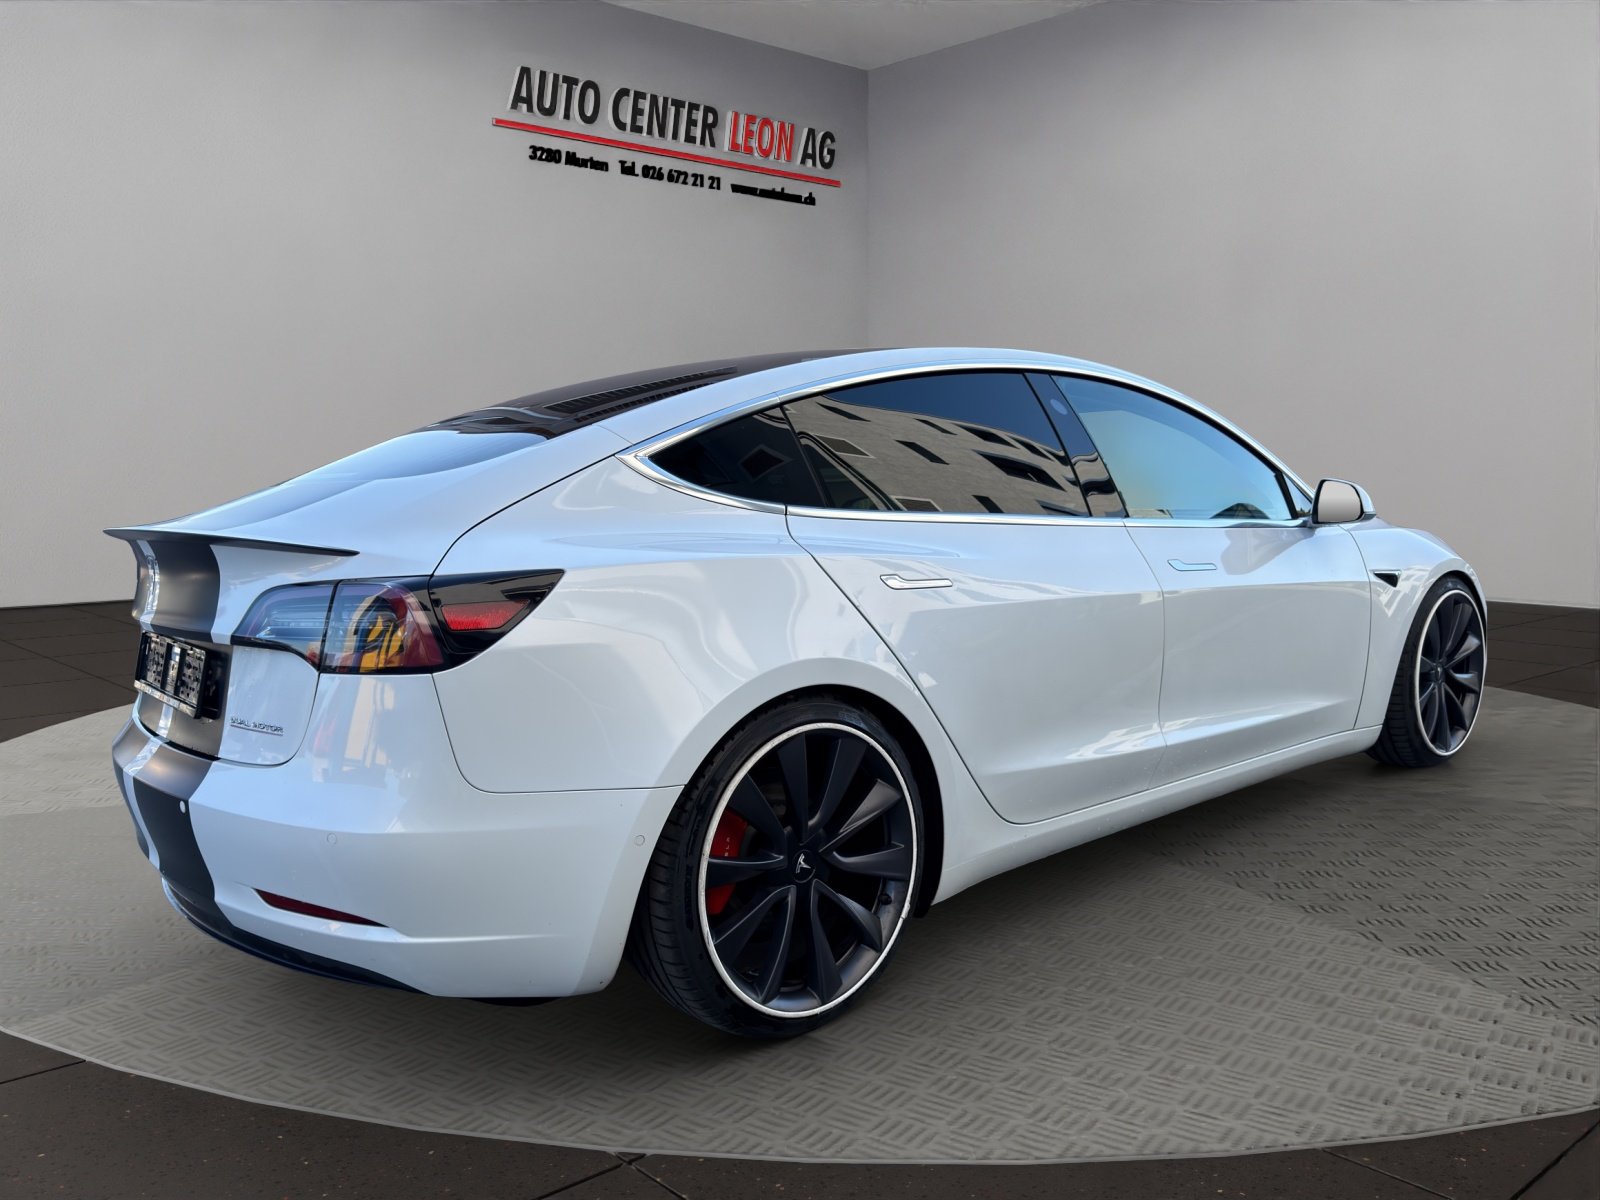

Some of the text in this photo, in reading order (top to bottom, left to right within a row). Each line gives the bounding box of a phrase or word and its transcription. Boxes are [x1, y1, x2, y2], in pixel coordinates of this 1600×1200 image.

[509, 65, 836, 170] AUTO CENTER LEON AG
[528, 144, 562, 164] 3280
[641, 164, 664, 181] 026
[666, 168, 689, 186] 672
[691, 173, 705, 188] 21
[707, 176, 721, 190] 21
[230, 716, 284, 733] DUAL MOTOR
